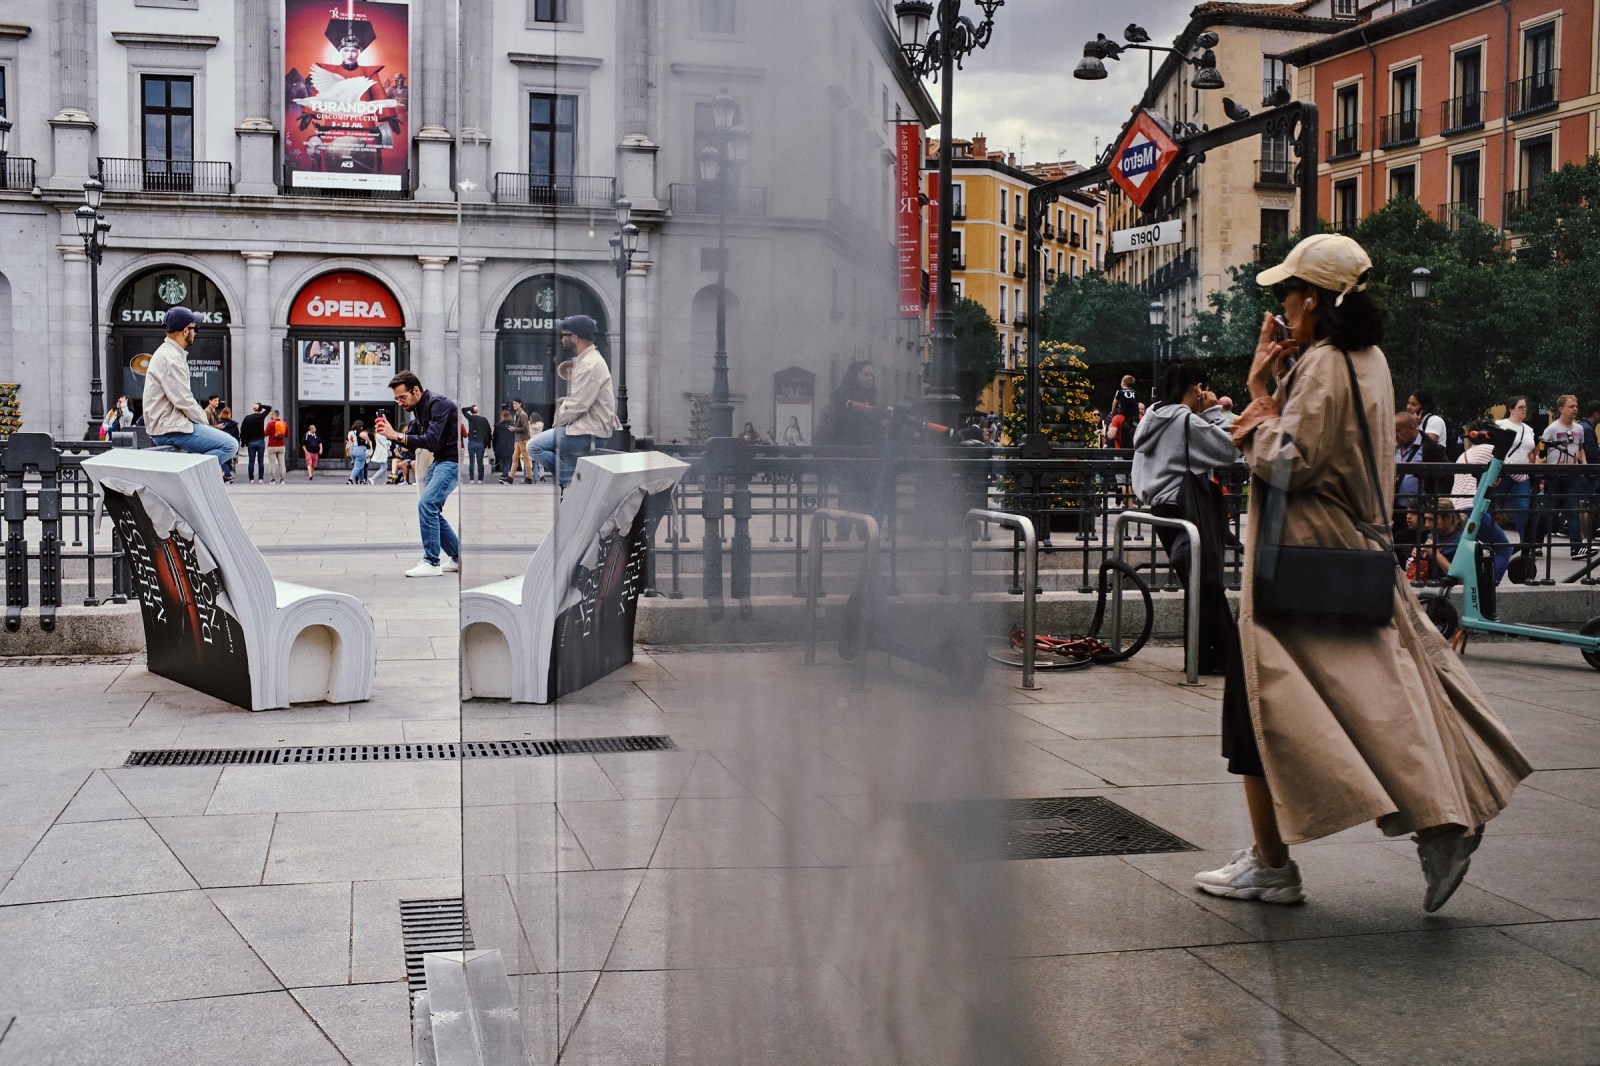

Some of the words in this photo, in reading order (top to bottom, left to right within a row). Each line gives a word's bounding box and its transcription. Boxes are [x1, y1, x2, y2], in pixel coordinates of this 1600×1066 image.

[310, 100, 383, 115] TURANDOT
[121, 309, 223, 324] STARKS
[307, 296, 386, 318] ÓPERA
[119, 518, 155, 608] RISTO
[122, 510, 168, 624] MEJIDE
